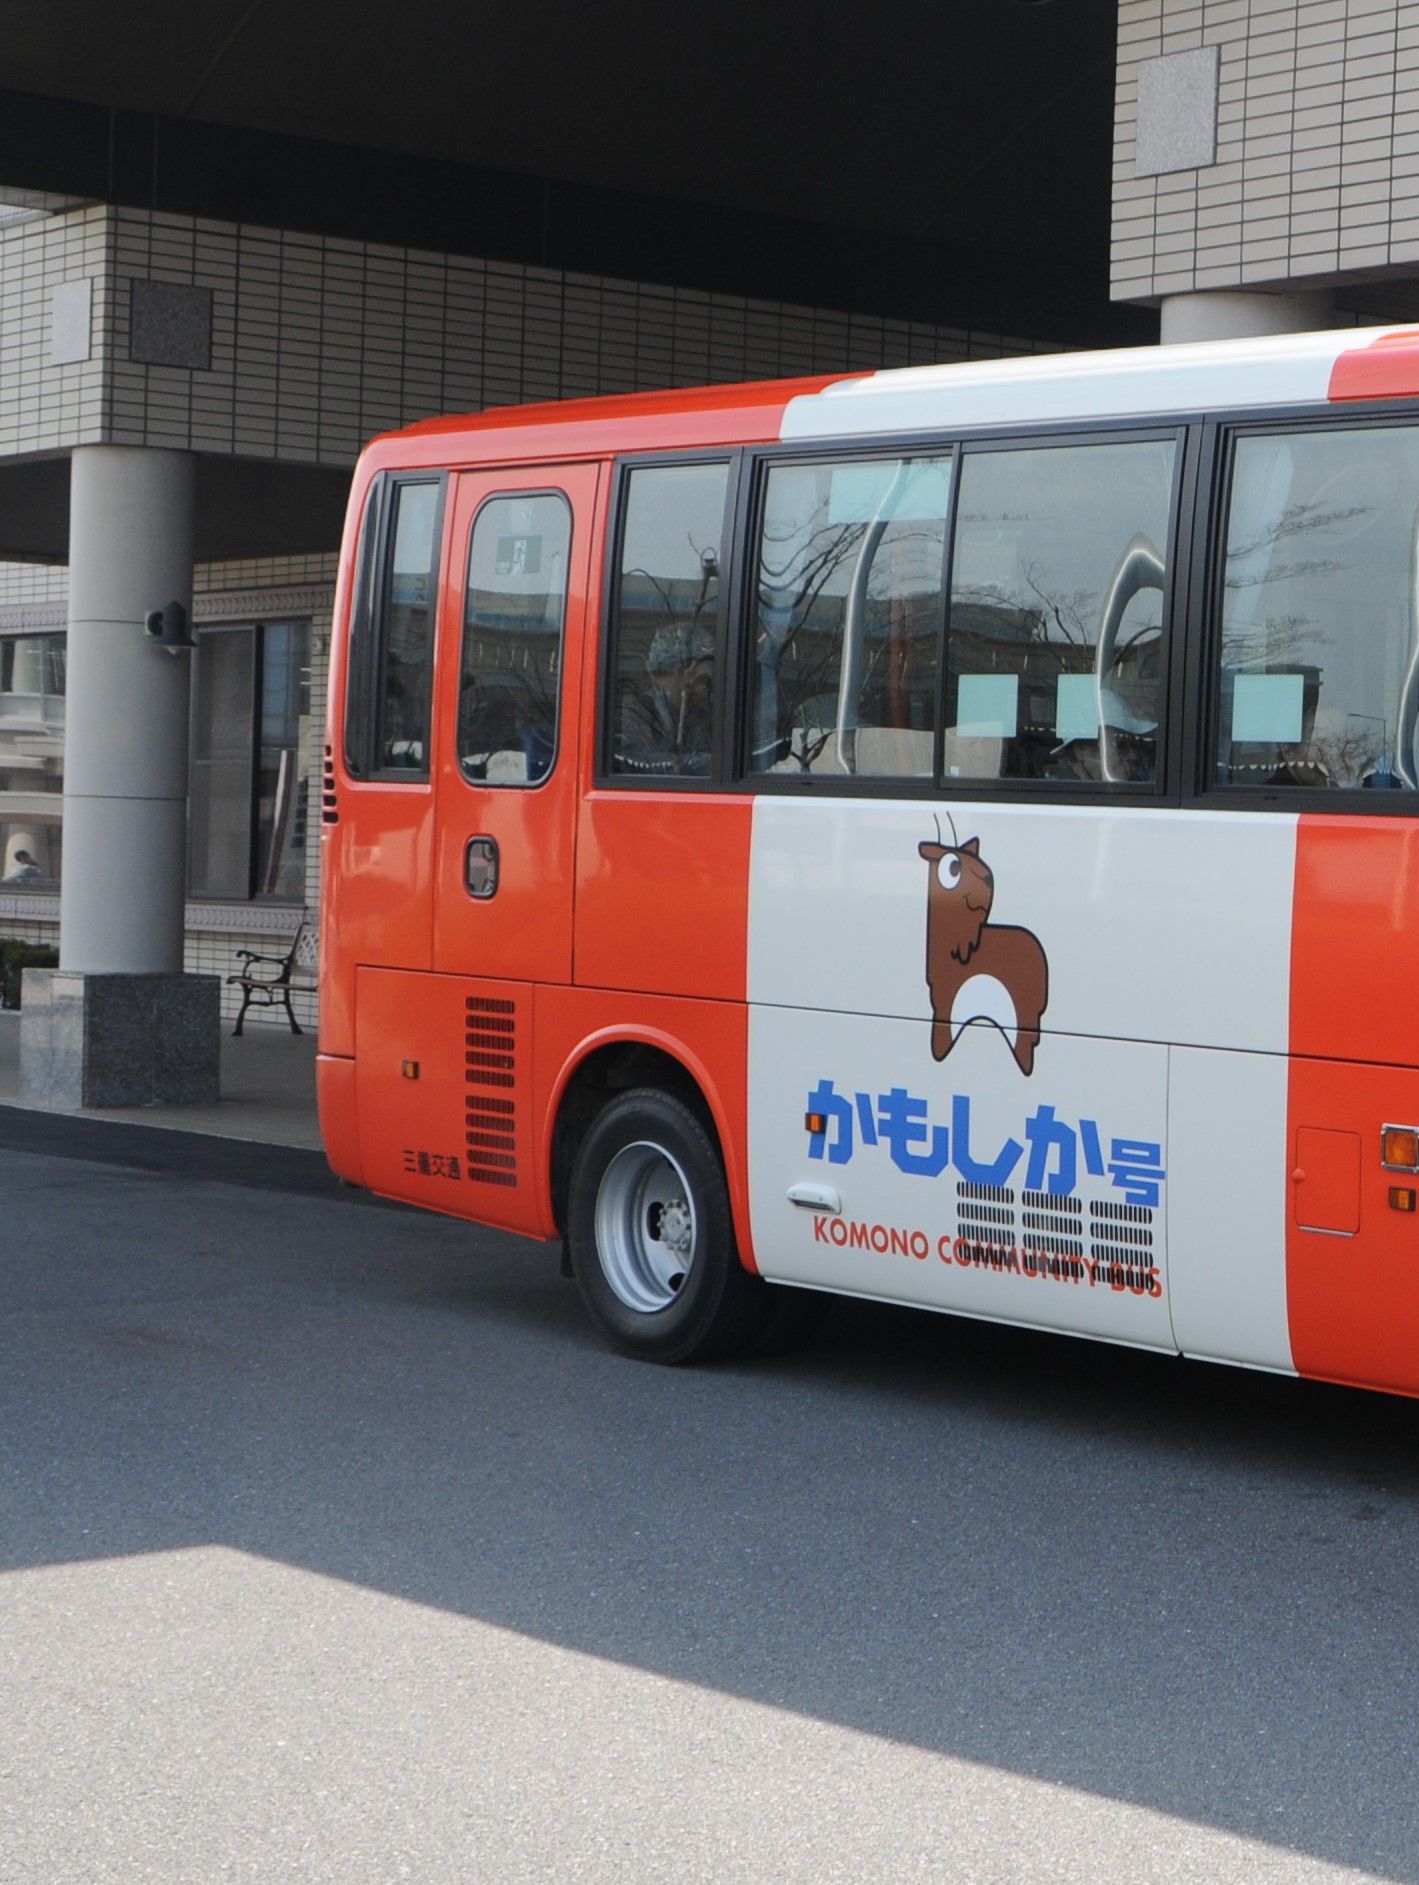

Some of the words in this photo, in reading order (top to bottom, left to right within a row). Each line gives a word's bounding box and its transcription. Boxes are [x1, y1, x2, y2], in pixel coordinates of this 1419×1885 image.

[807, 1079, 1166, 1208] かもしか号
[814, 1216, 930, 1260] KOMONO
[937, 1234, 1100, 1288] COMMUNITY
[1110, 1261, 1163, 1298] BUS
